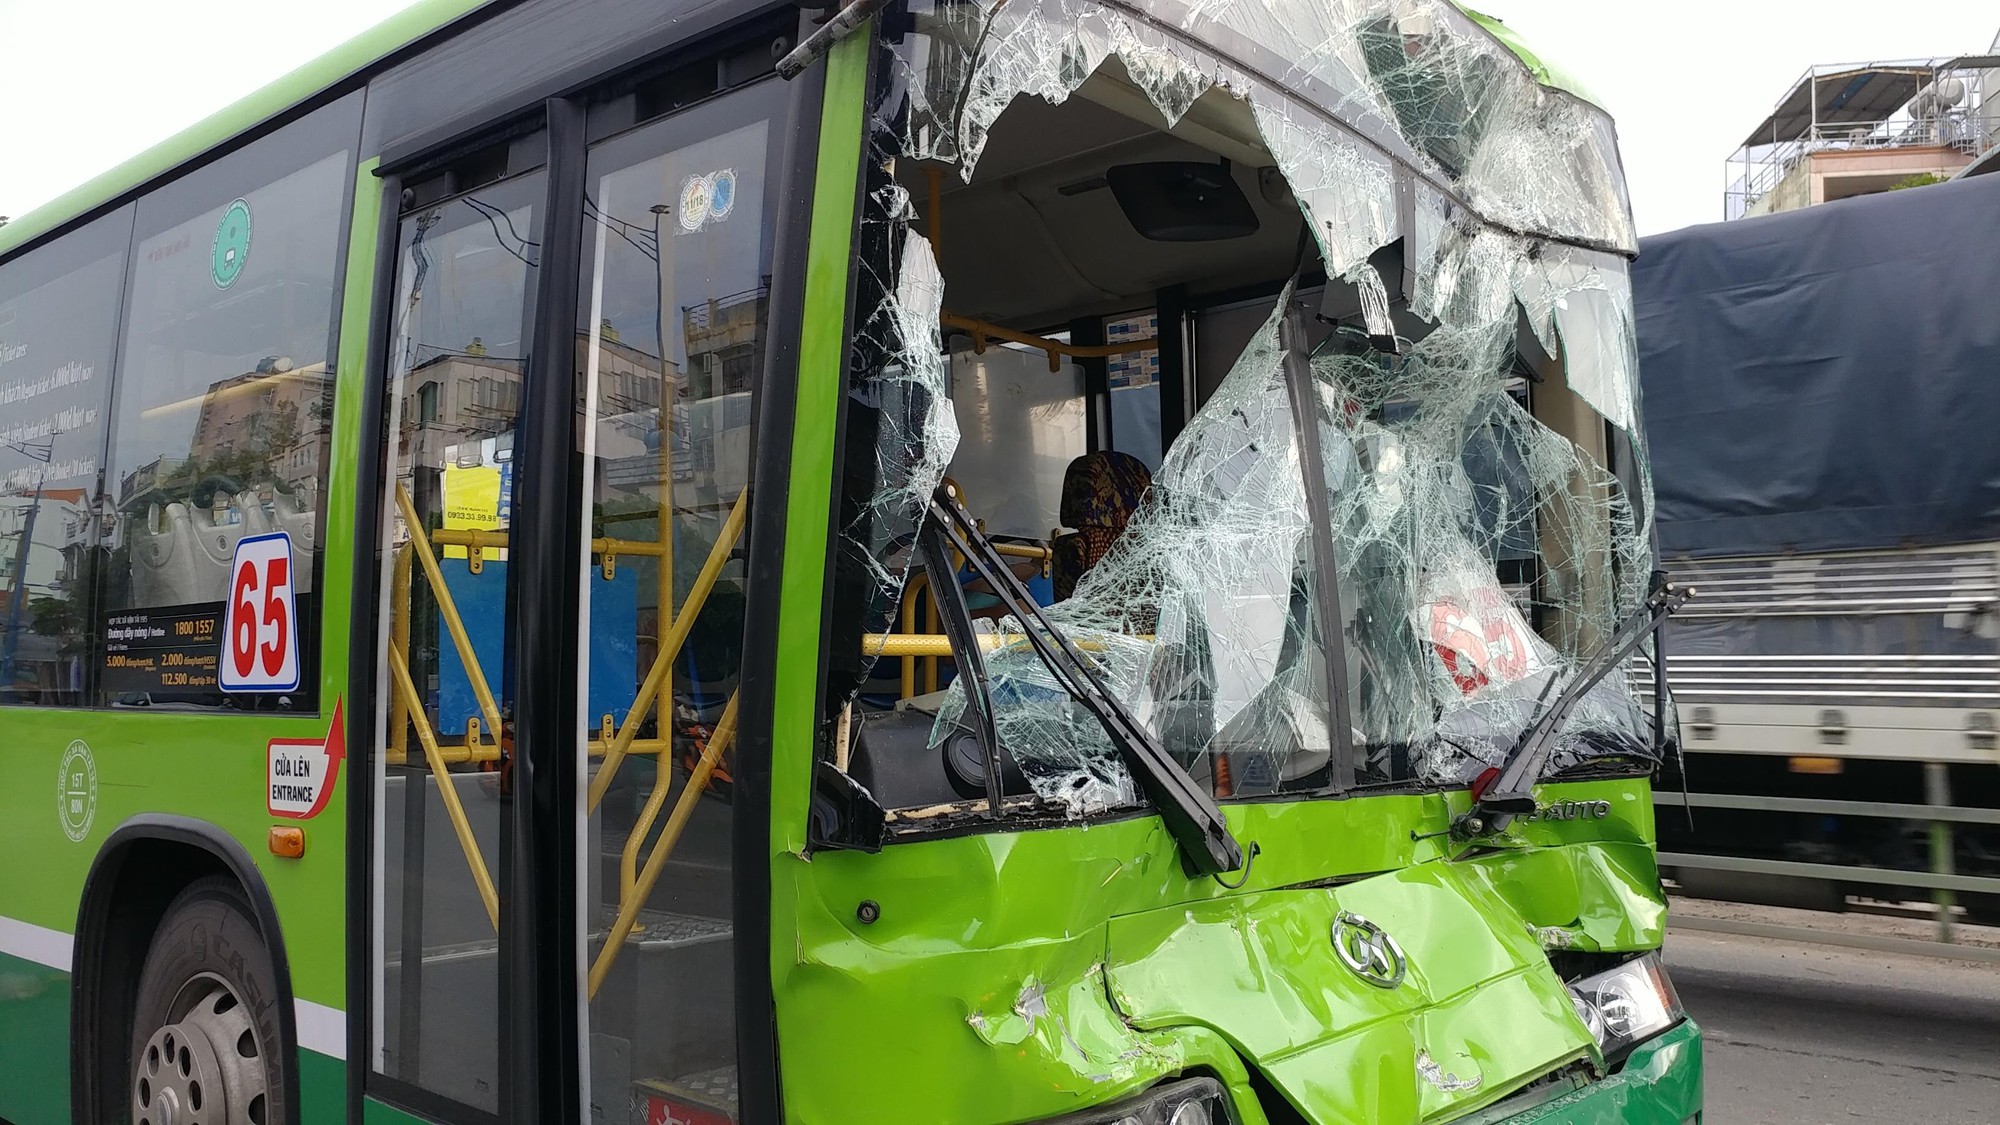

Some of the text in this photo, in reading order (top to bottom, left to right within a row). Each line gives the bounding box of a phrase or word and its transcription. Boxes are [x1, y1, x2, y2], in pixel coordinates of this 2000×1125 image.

[233, 557, 288, 678] 65
[175, 619, 215, 635] 1800 1557
[106, 655, 126, 669] 5.000
[161, 653, 183, 666] 2.000
[161, 672, 187, 685] 112.500
[275, 753, 310, 778] CỬA LÊN
[71, 773, 84, 788] 15T
[272, 785, 313, 803] ENTRANCE
[1546, 799, 1611, 821] AUTO
